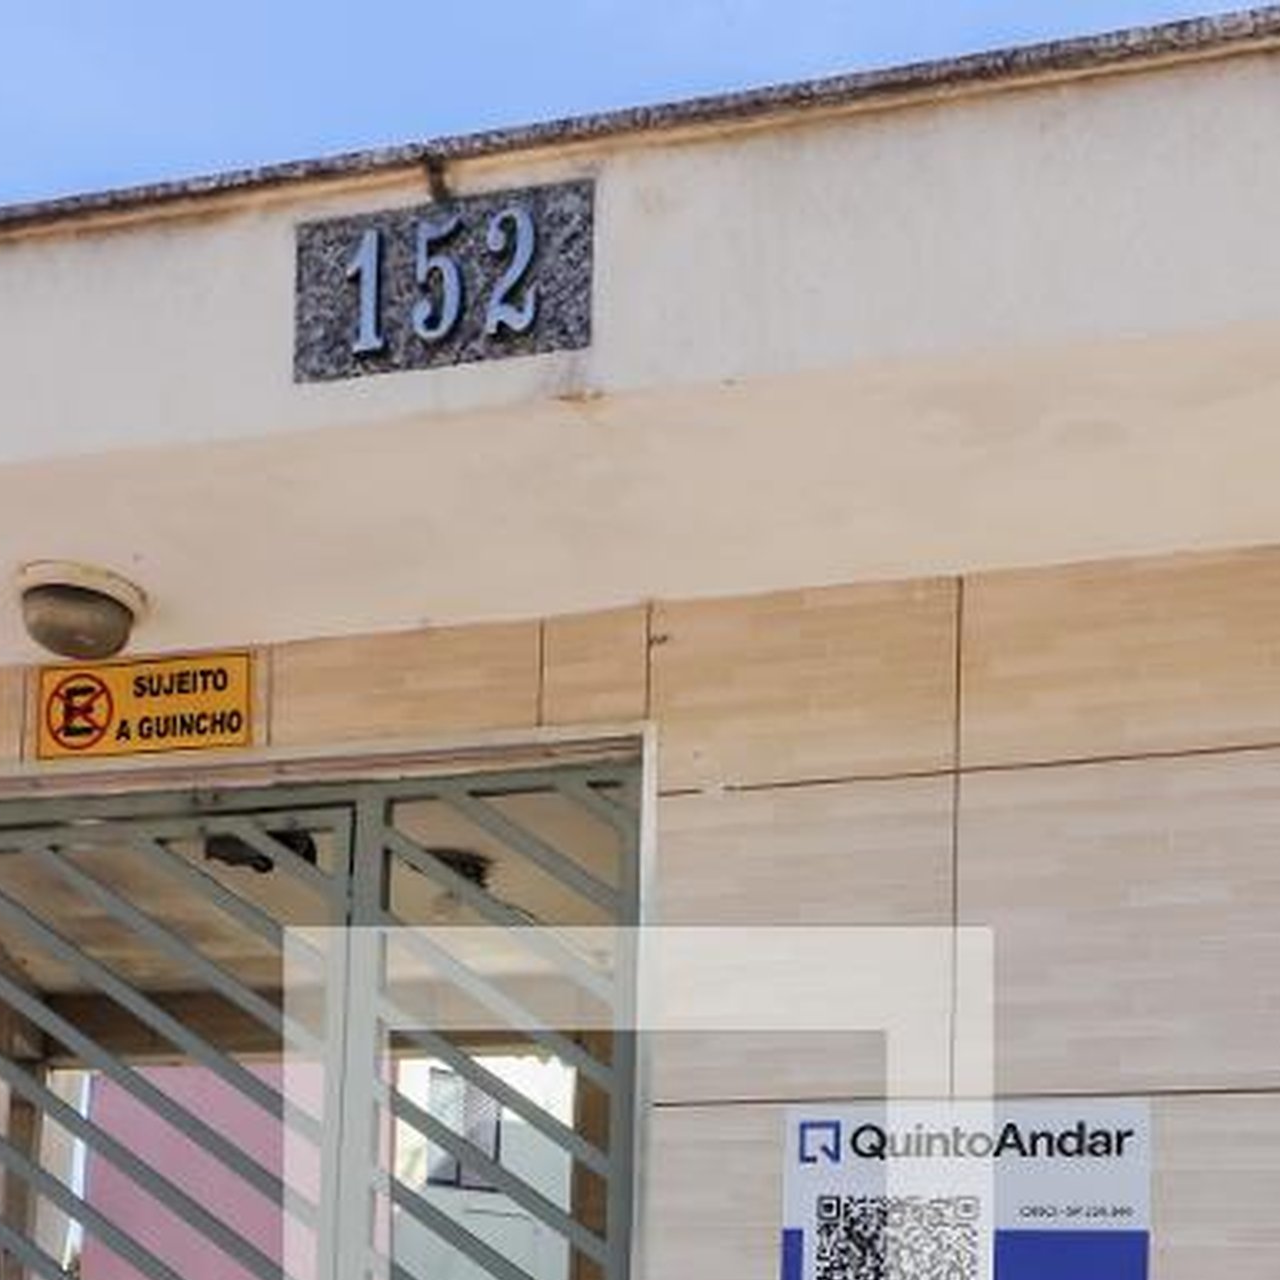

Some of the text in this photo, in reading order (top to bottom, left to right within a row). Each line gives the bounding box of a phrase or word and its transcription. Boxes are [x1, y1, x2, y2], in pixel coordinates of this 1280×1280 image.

[346, 205, 540, 352] 152
[132, 668, 228, 698] SUJEITO
[115, 709, 243, 741] A GUINCHO
[849, 1120, 1135, 1161] QuintoAndar
